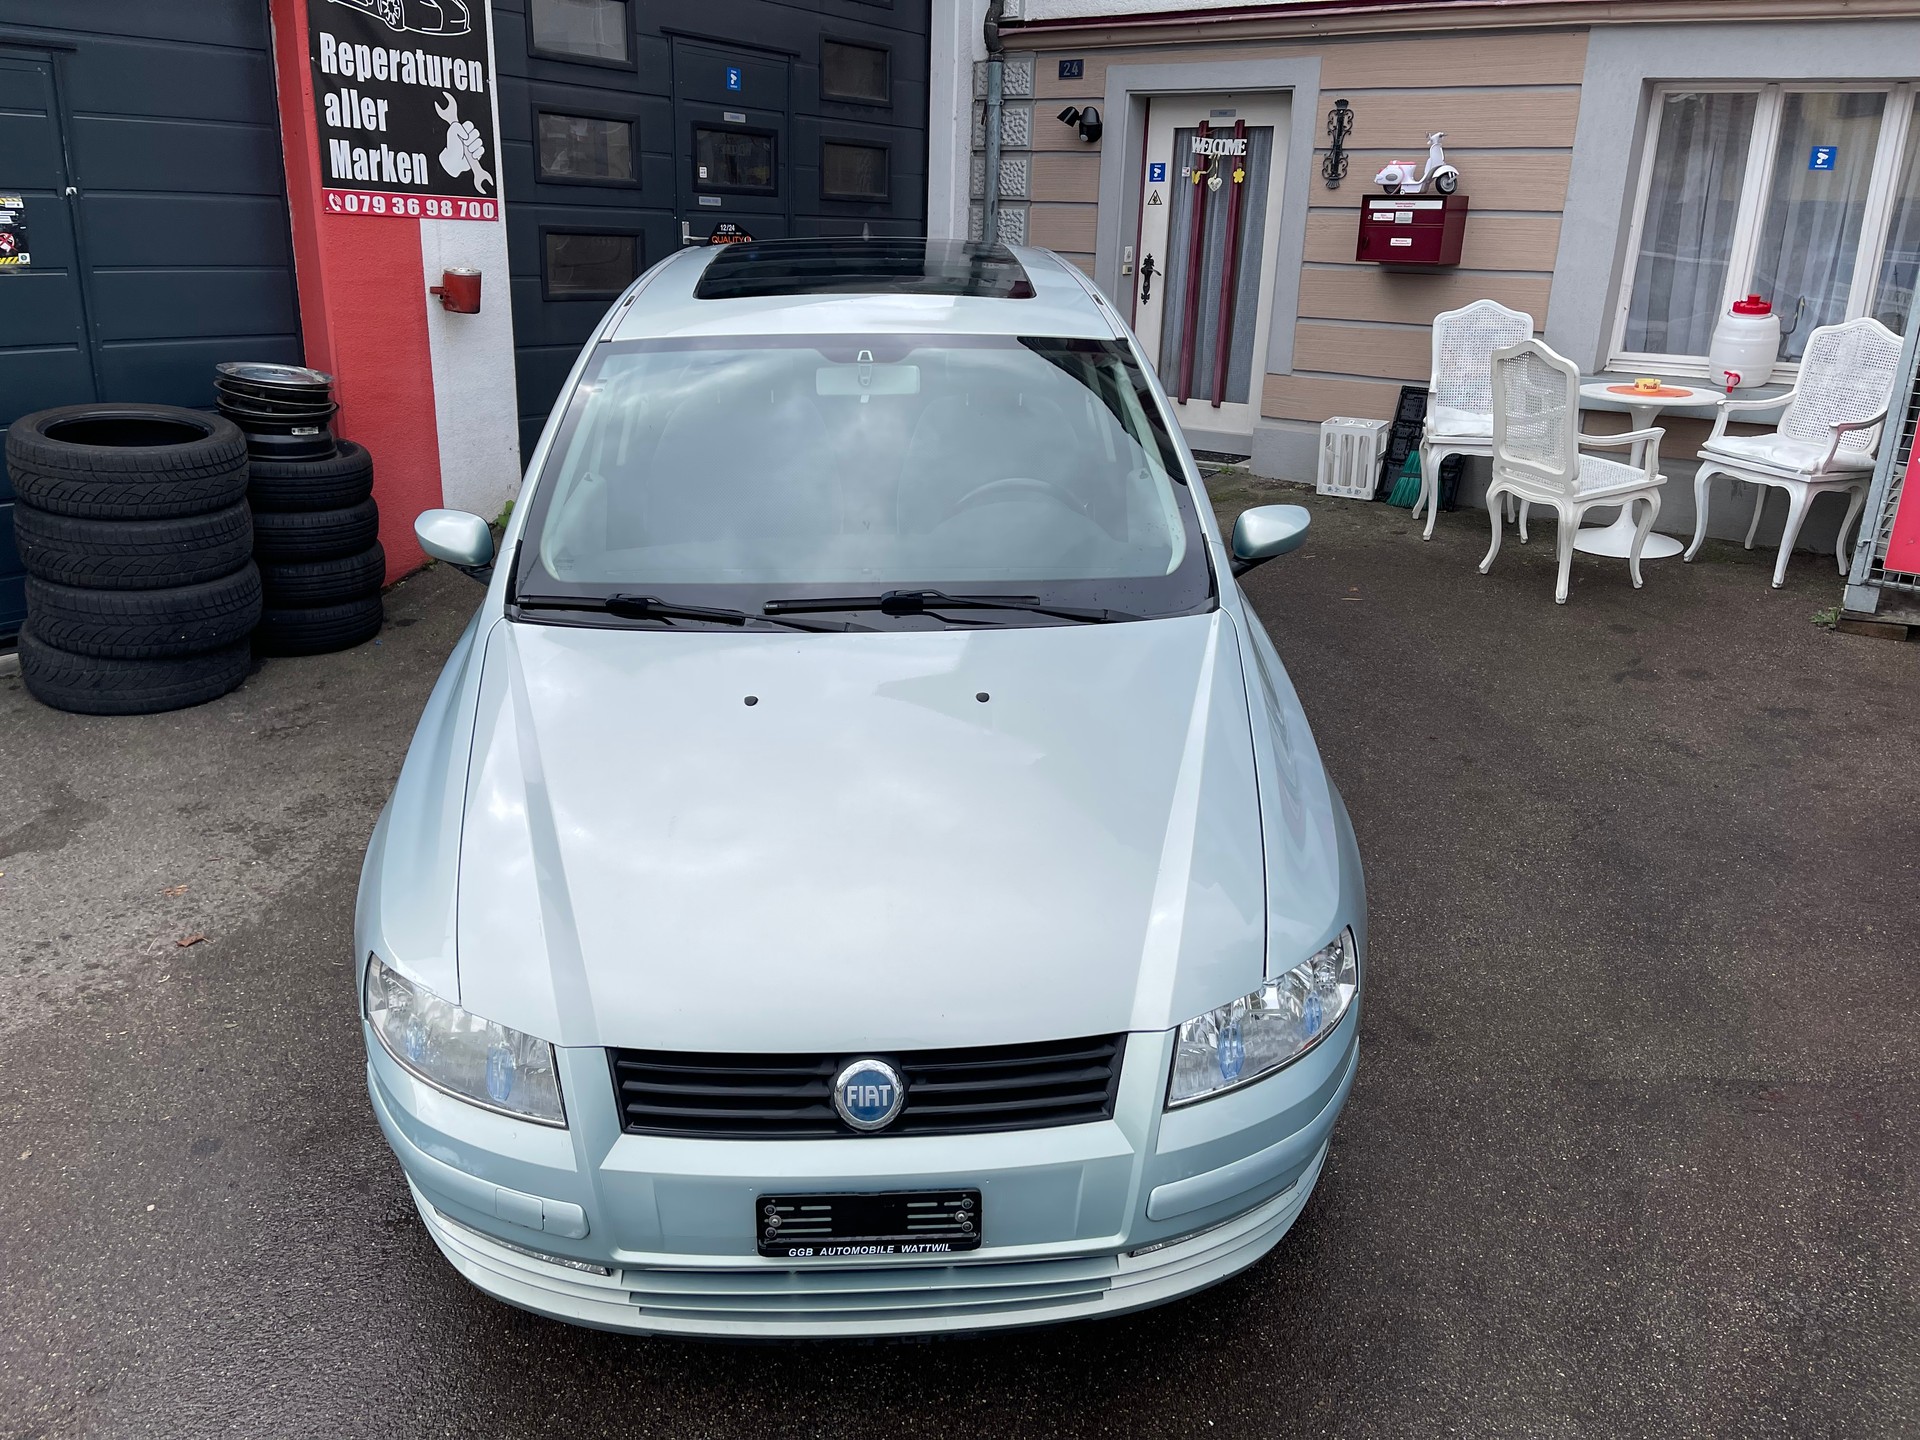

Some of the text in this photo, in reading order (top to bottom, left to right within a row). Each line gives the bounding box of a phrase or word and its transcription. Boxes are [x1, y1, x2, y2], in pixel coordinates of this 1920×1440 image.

[319, 32, 484, 93] Reperaturen
[1063, 62, 1079, 76] 24
[324, 88, 389, 132] aller
[1191, 136, 1248, 156] WELCOME
[329, 139, 429, 185] Marken
[344, 194, 495, 219] 079 36 98 700
[847, 1084, 891, 1107] FIAT
[788, 1243, 952, 1257] GGB AUTOMOBILE WATTWIL
